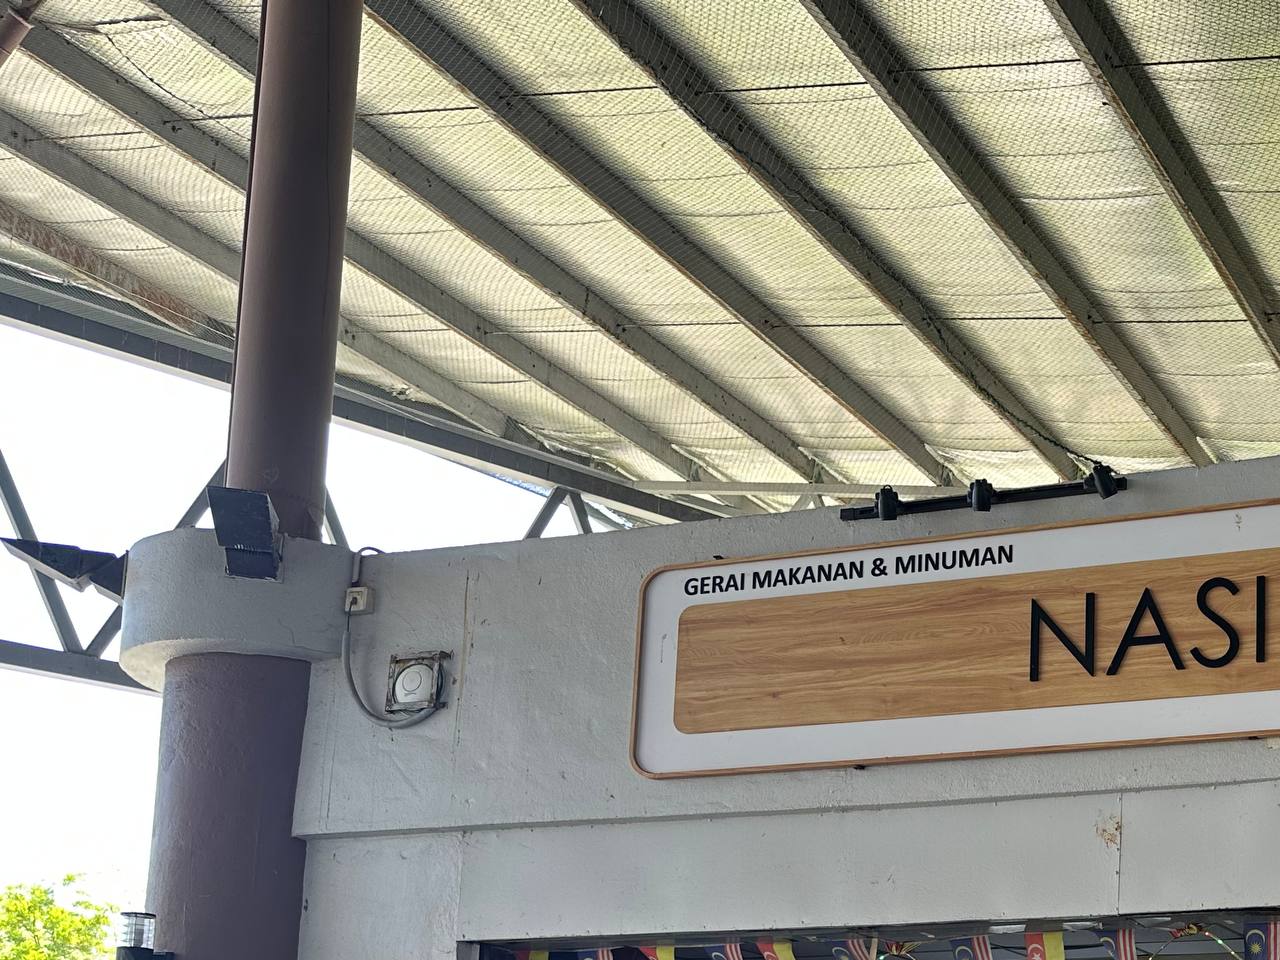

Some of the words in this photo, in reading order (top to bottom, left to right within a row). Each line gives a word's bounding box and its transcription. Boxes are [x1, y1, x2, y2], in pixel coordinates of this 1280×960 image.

[684, 573, 746, 596] GERAI
[751, 559, 865, 590] MAKANAN
[870, 558, 888, 577] &
[895, 544, 1013, 574] MINUMAN
[1030, 575, 1266, 683] NASI
